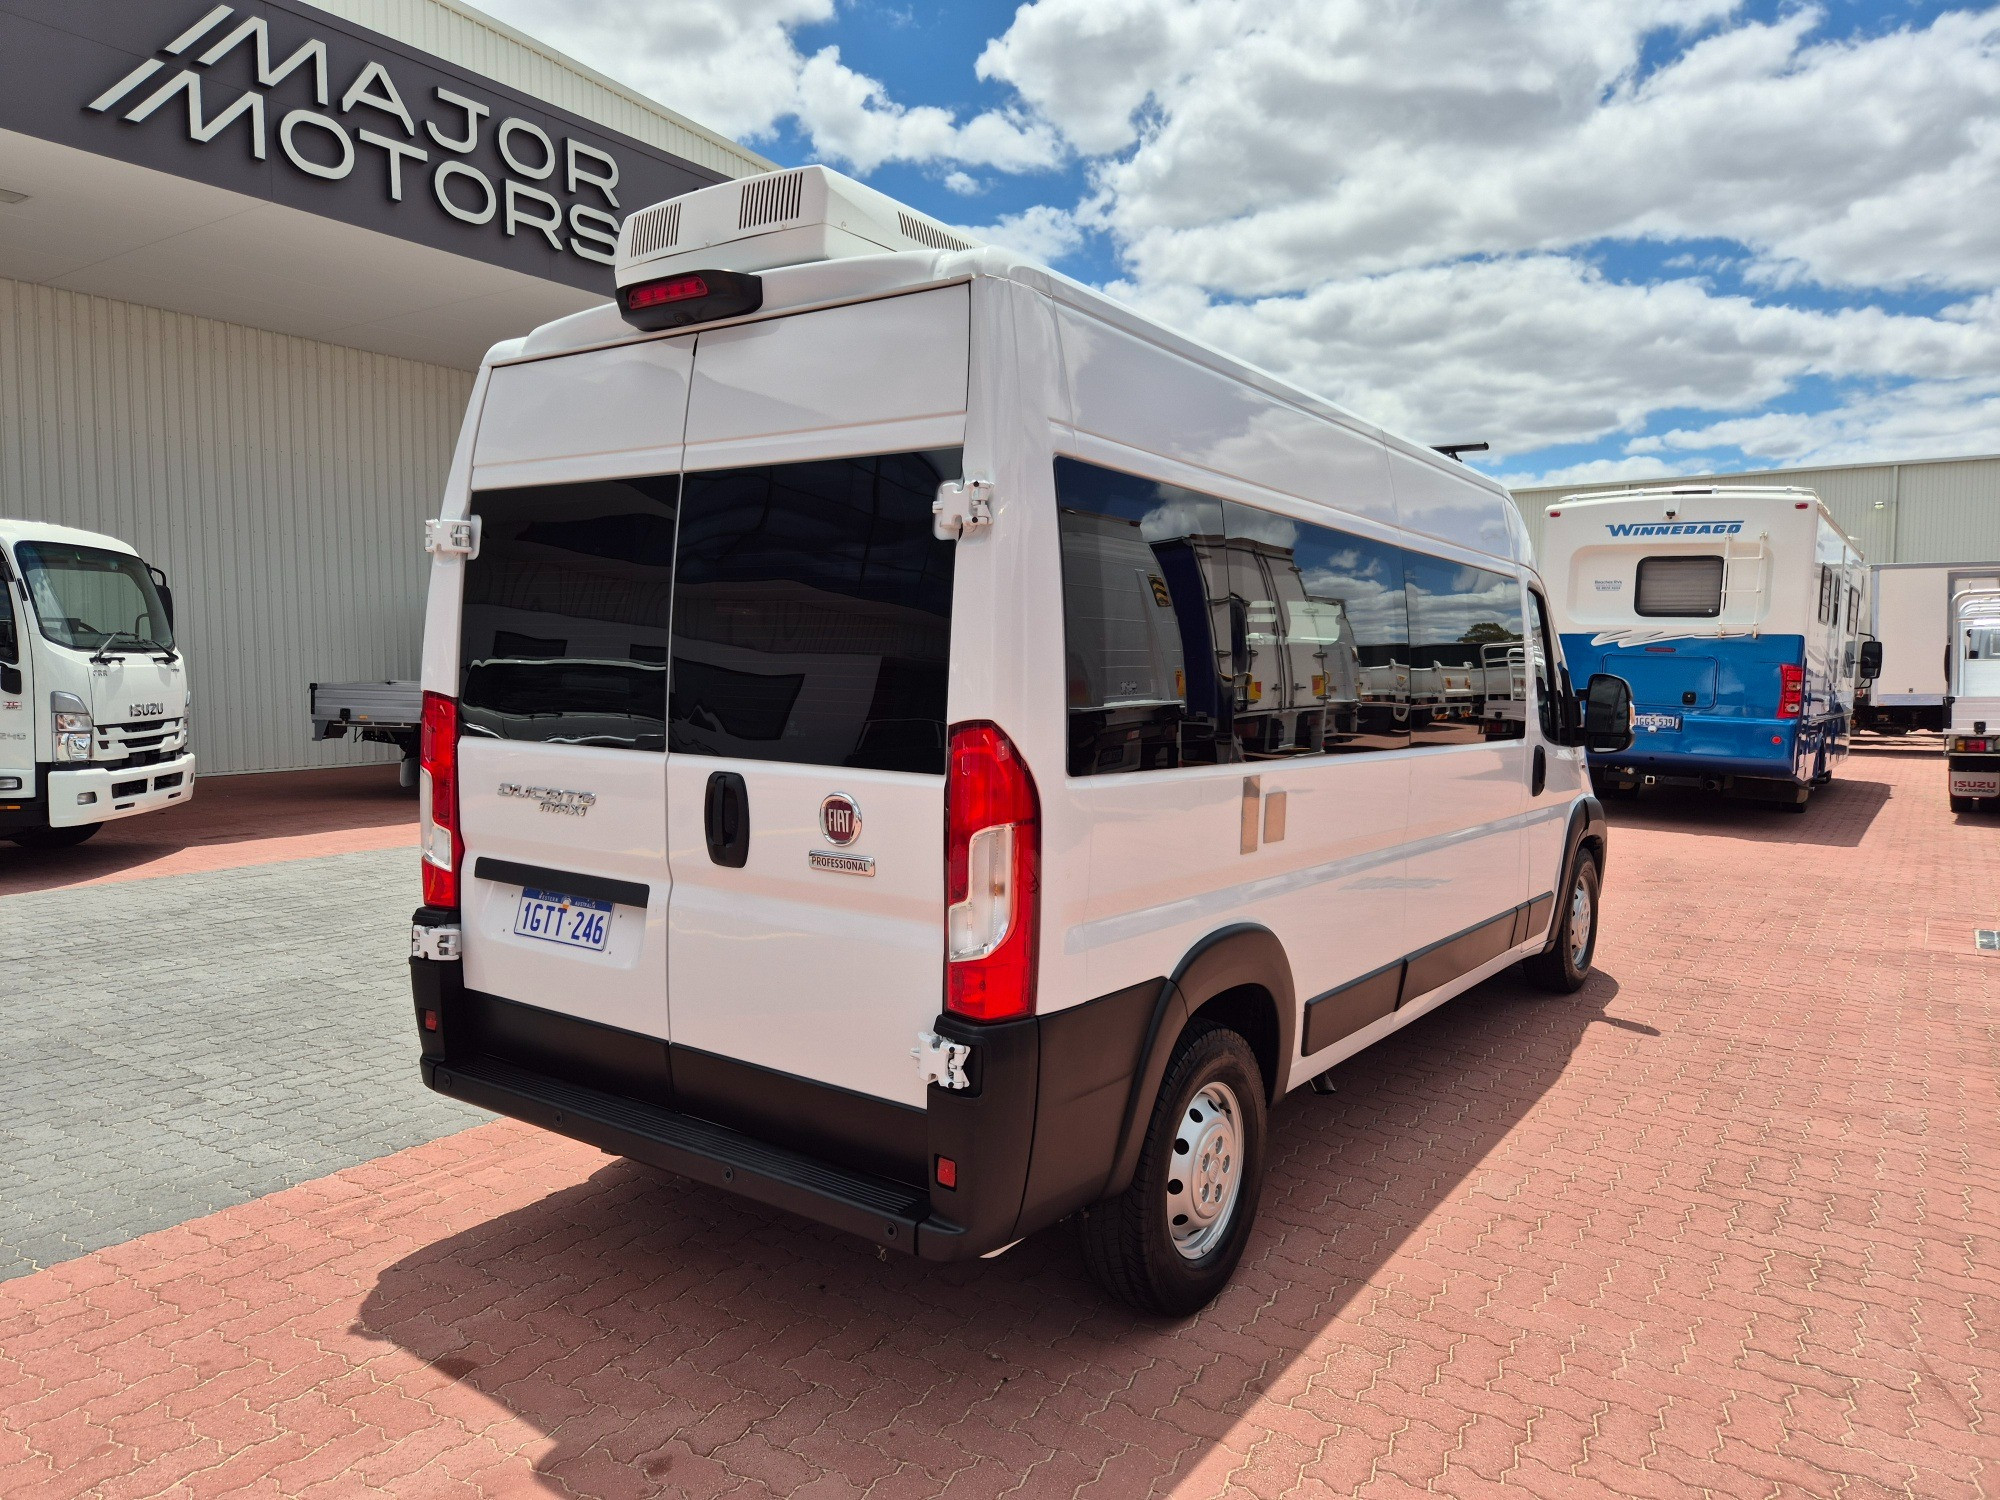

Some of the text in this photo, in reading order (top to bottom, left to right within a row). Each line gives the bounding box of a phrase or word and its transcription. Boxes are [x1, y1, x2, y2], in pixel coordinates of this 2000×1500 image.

[160, 4, 621, 209] MAJOR
[83, 57, 622, 267] MOTORS
[1605, 520, 1745, 537] WINNEBAGO
[129, 702, 164, 717] ISUZU
[1954, 780, 1997, 789] ISUZU
[828, 808, 852, 833] FIAT
[811, 856, 868, 872] PROFESSIONAL
[574, 900, 596, 909] AUSTRALIA
